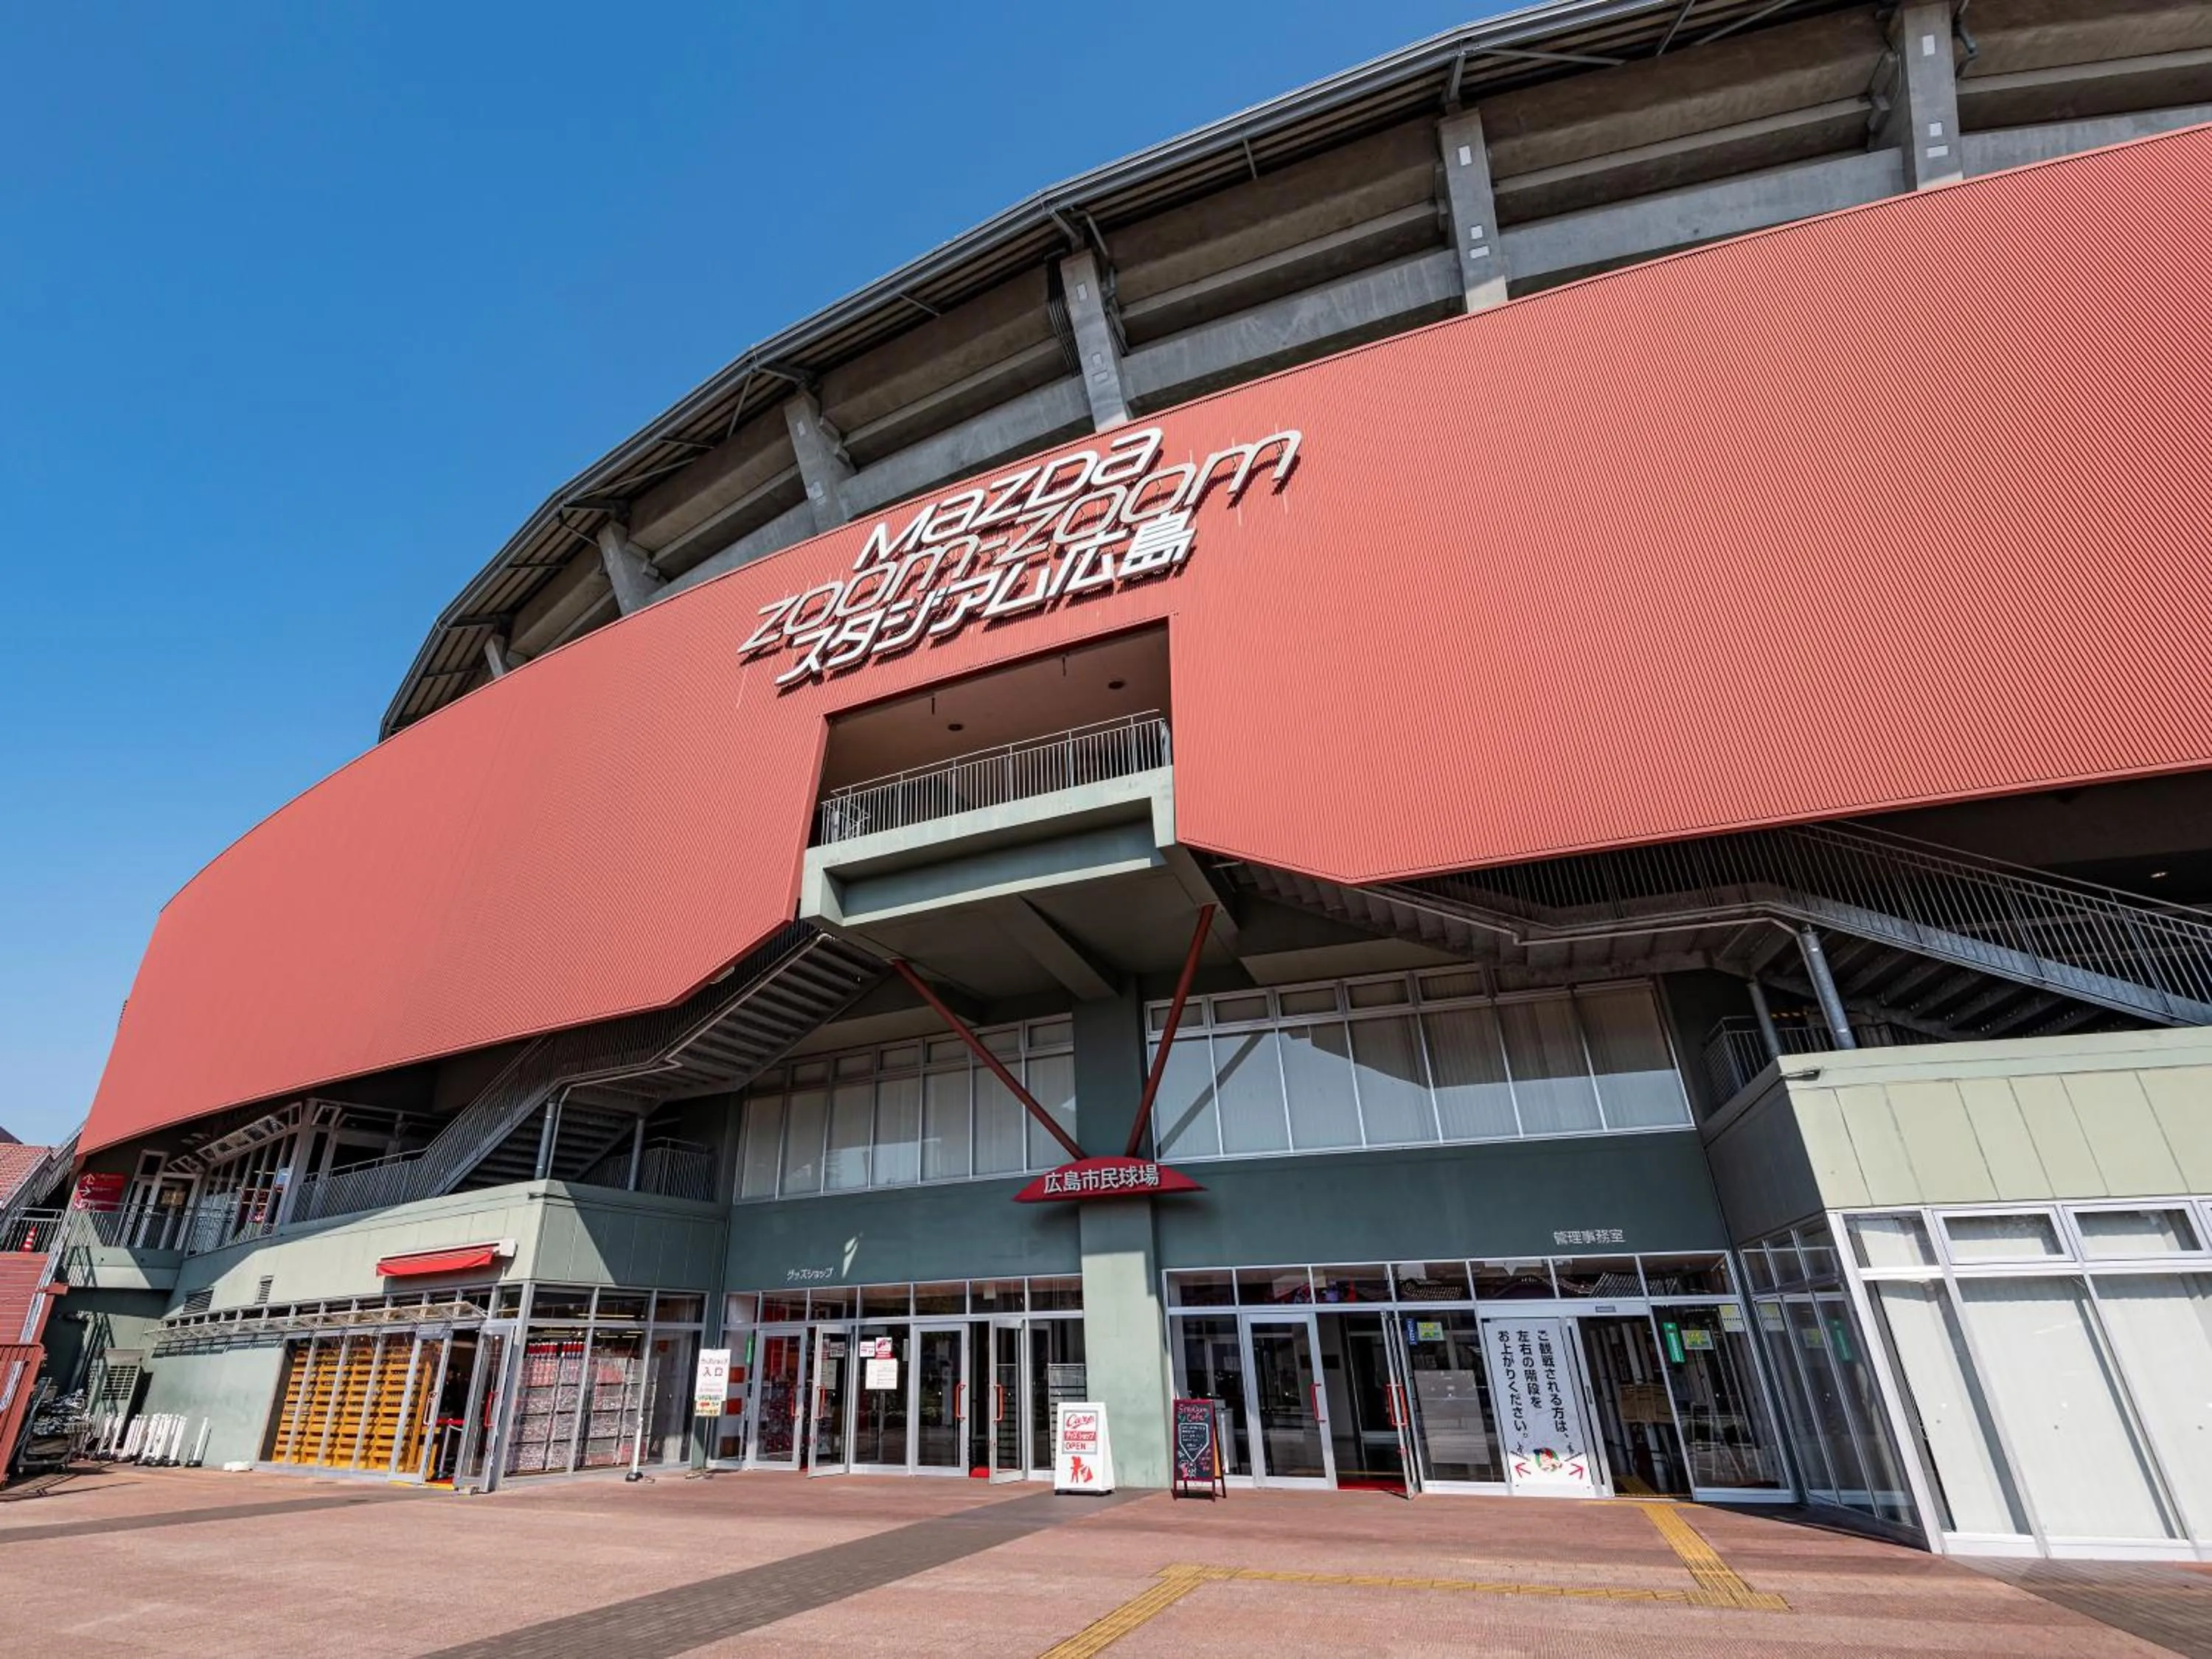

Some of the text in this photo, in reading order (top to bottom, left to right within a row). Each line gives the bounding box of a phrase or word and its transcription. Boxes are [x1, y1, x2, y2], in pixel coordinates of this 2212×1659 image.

[776, 511, 1199, 686] スタジアム広島
[1043, 1164, 1159, 1194] 広島市民球場
[1554, 1229, 1626, 1245] 管理事務室
[787, 1267, 834, 1281] グッズショップ
[703, 1367, 723, 1377] 入口
[1498, 1330, 1528, 1438] お上がりください。
[1517, 1330, 1543, 1409] 左右の階段を
[1537, 1329, 1569, 1438] ご観戦される方は、
[1065, 1442, 1086, 1450] OPEN
